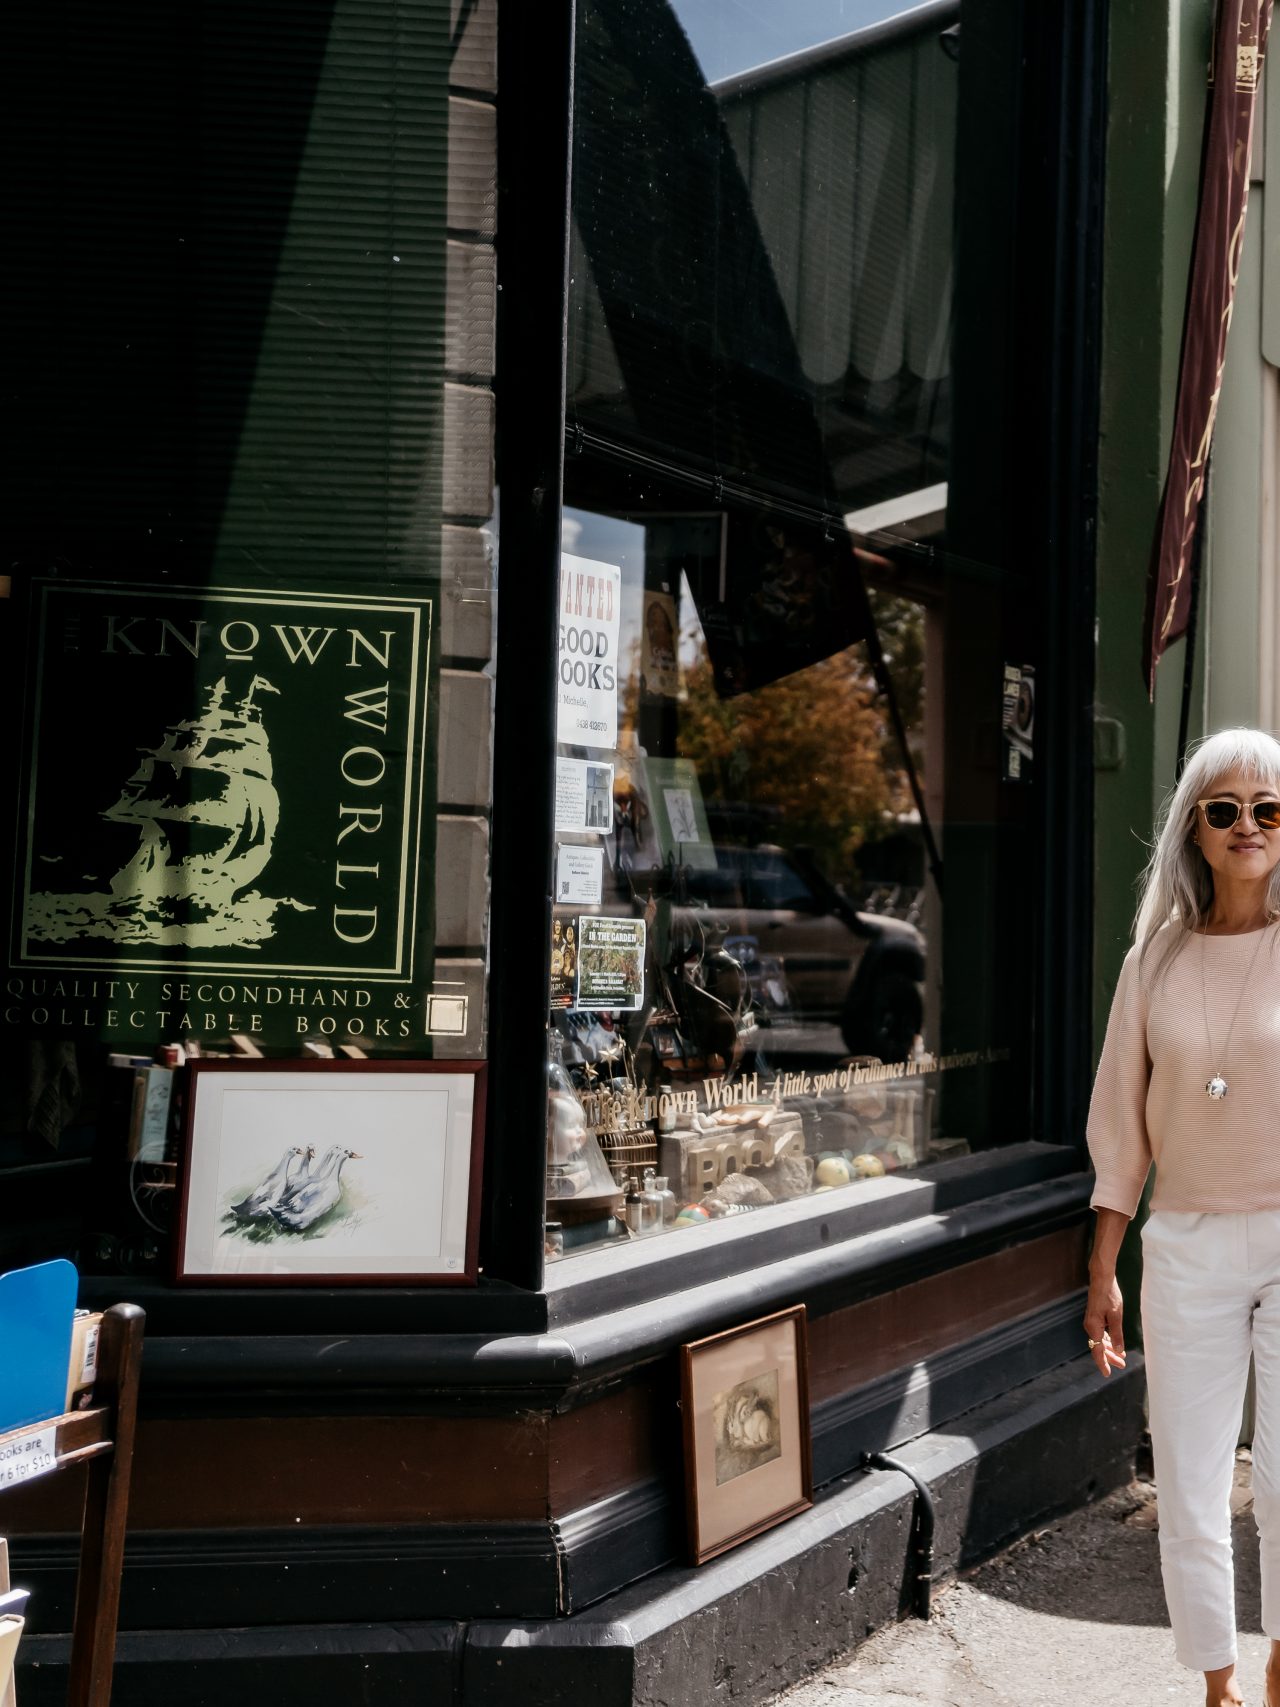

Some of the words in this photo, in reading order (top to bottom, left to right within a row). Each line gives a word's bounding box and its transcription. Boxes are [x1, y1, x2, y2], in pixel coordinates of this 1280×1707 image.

[560, 569, 613, 621] ANTED
[101, 615, 396, 669] KNOWN
[558, 658, 615, 691] OOKS
[333, 680, 390, 944] WORLD
[597, 932, 610, 941] THE
[611, 932, 636, 942] GARDEN
[7, 978, 141, 999] QUALITY
[162, 983, 372, 1008] SECONDHAND
[394, 992, 411, 1009] &
[5, 1006, 263, 1031] COLLECTABLE
[297, 1015, 411, 1036] BOOKS
[629, 1088, 698, 1129] Known
[703, 1072, 758, 1110] World
[770, 1075, 781, 1098] A
[783, 1070, 811, 1097] little
[813, 1070, 838, 1098] spot
[839, 1063, 853, 1092] of
[854, 1060, 904, 1085] brilliance
[26, 1439, 42, 1452] are
[16, 1464, 29, 1476] for
[33, 1453, 50, 1470] $10
